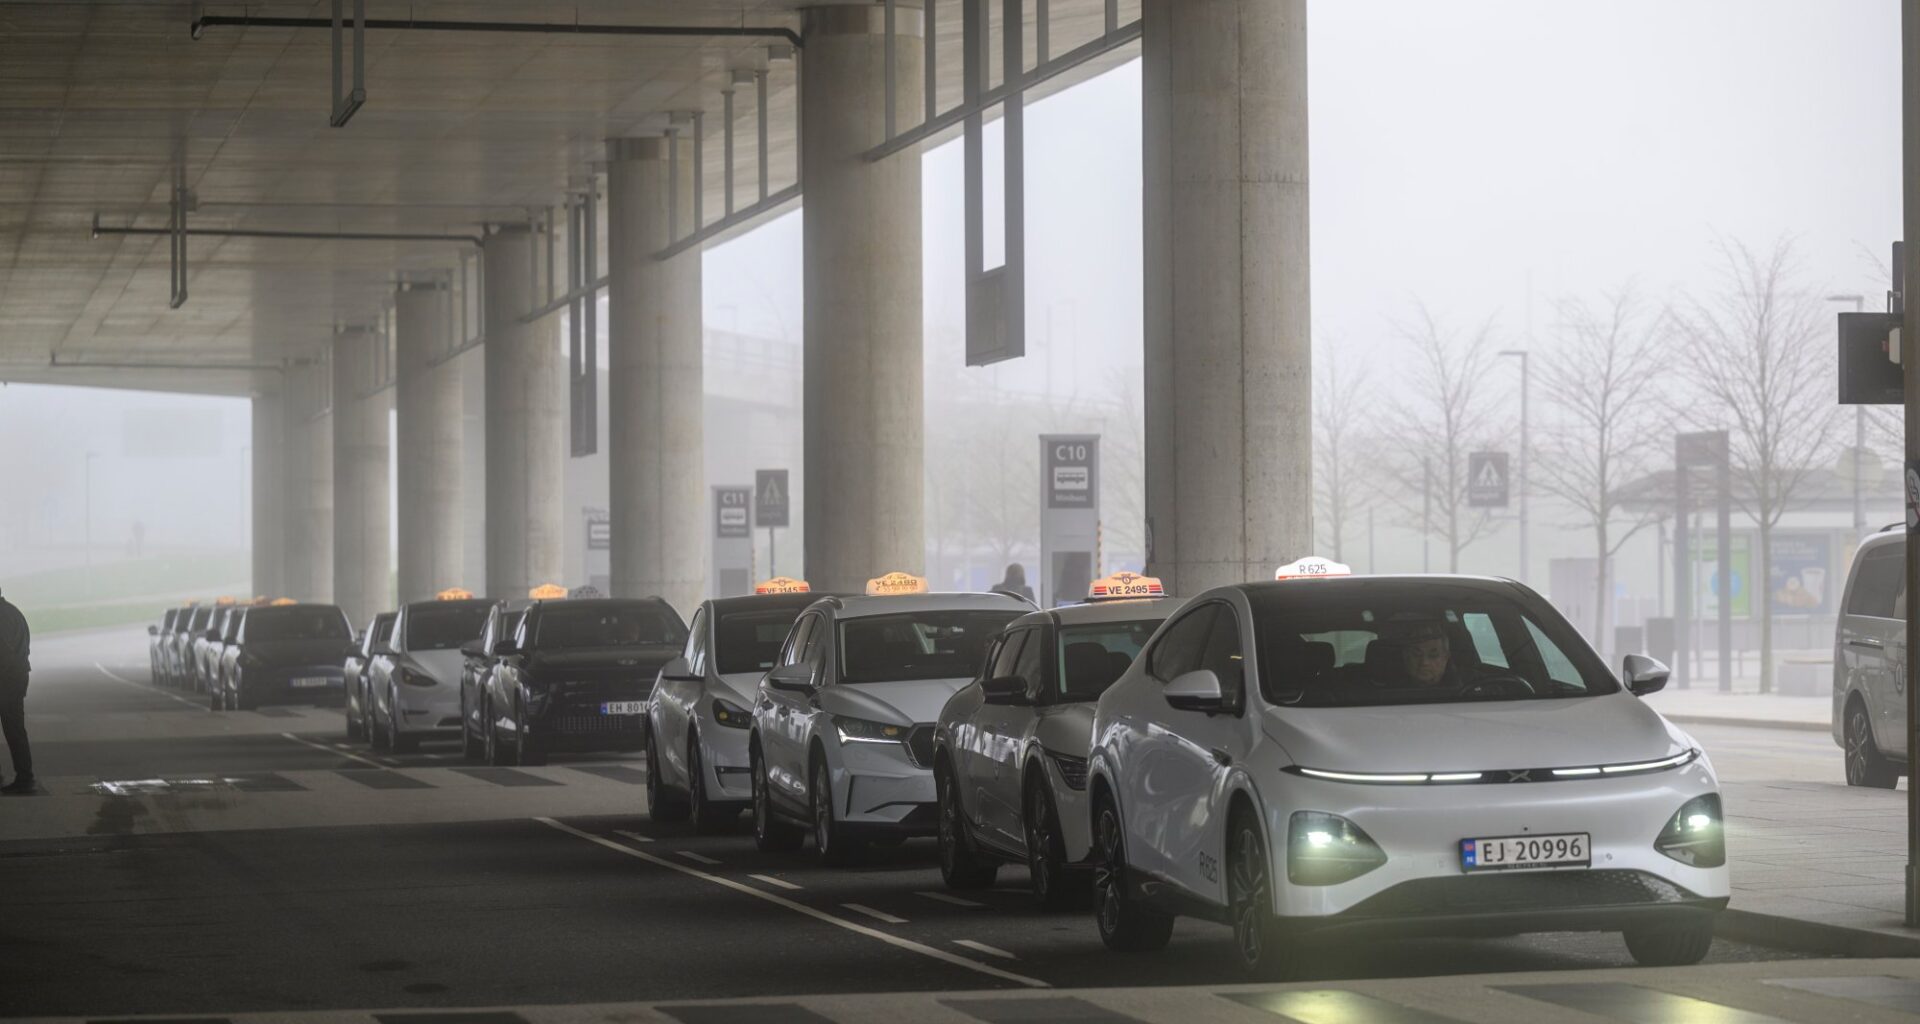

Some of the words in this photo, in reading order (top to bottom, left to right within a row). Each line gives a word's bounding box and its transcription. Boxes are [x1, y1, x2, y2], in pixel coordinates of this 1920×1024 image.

[1056, 444, 1086, 461] C10
[722, 492, 744, 505] C11
[1299, 564, 1306, 575] R
[1308, 563, 1328, 575] 625
[1108, 585, 1123, 595] VE
[1124, 584, 1149, 595] 2495
[609, 703, 623, 713] EH
[1483, 841, 1505, 863] EJ
[1515, 837, 1582, 862] 20996
